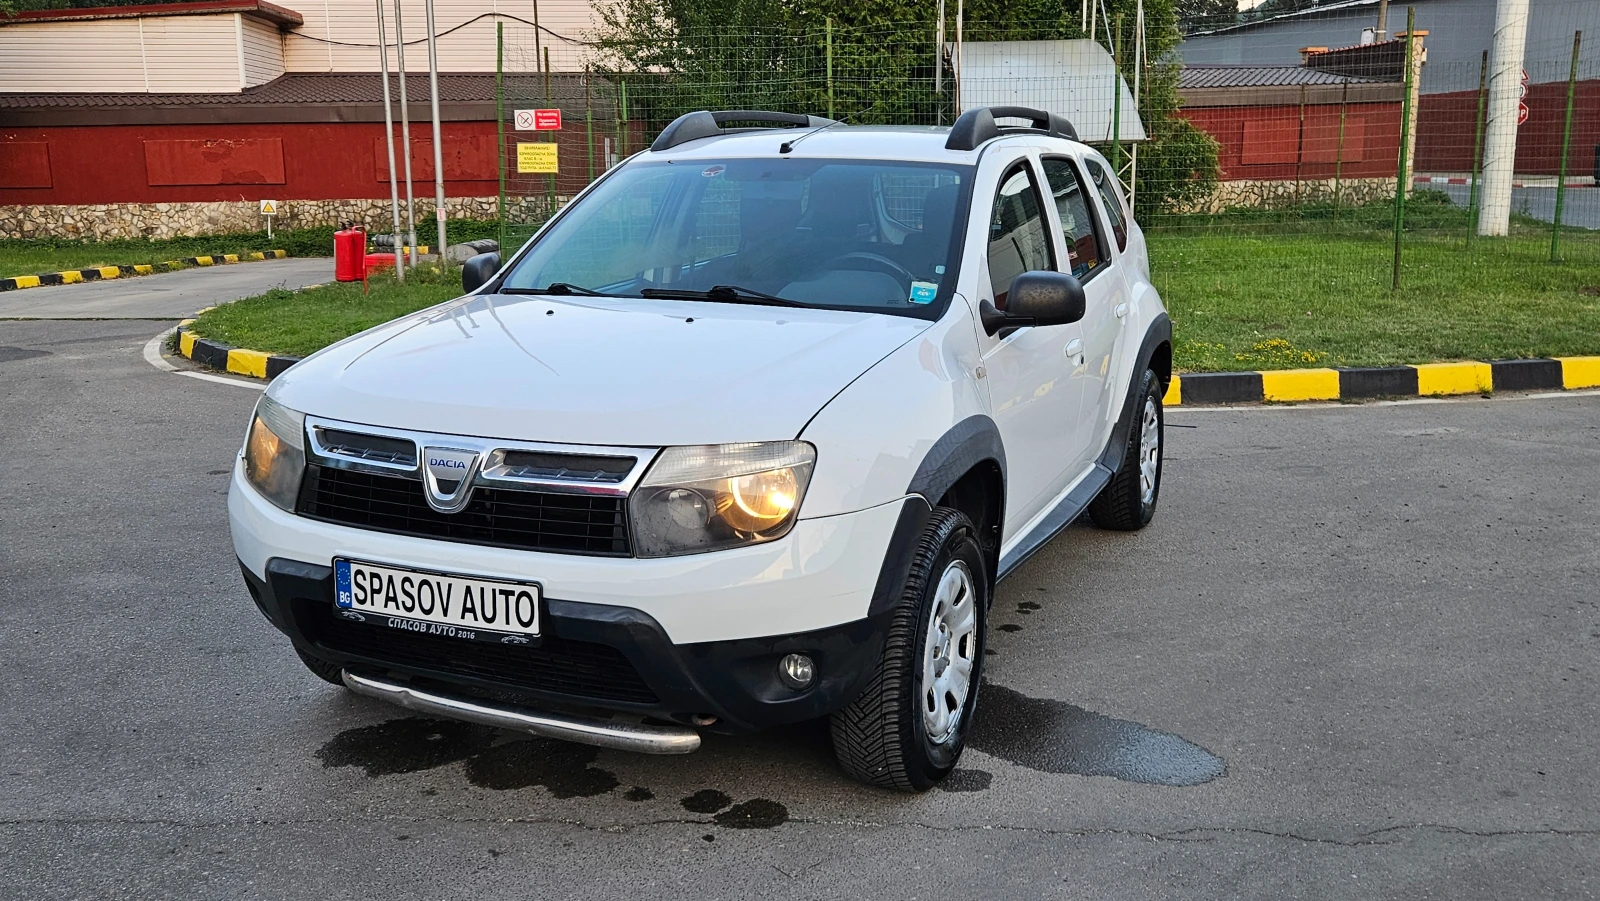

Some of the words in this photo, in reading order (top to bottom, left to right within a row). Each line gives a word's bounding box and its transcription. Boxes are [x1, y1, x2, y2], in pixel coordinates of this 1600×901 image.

[430, 459, 465, 469] DACIA
[339, 591, 350, 604] BG
[353, 568, 452, 618] SPASOV
[460, 585, 535, 628] AUTO
[388, 617, 427, 633] СПАСОВ
[428, 624, 456, 637] АУТО
[457, 630, 476, 640] 2016
